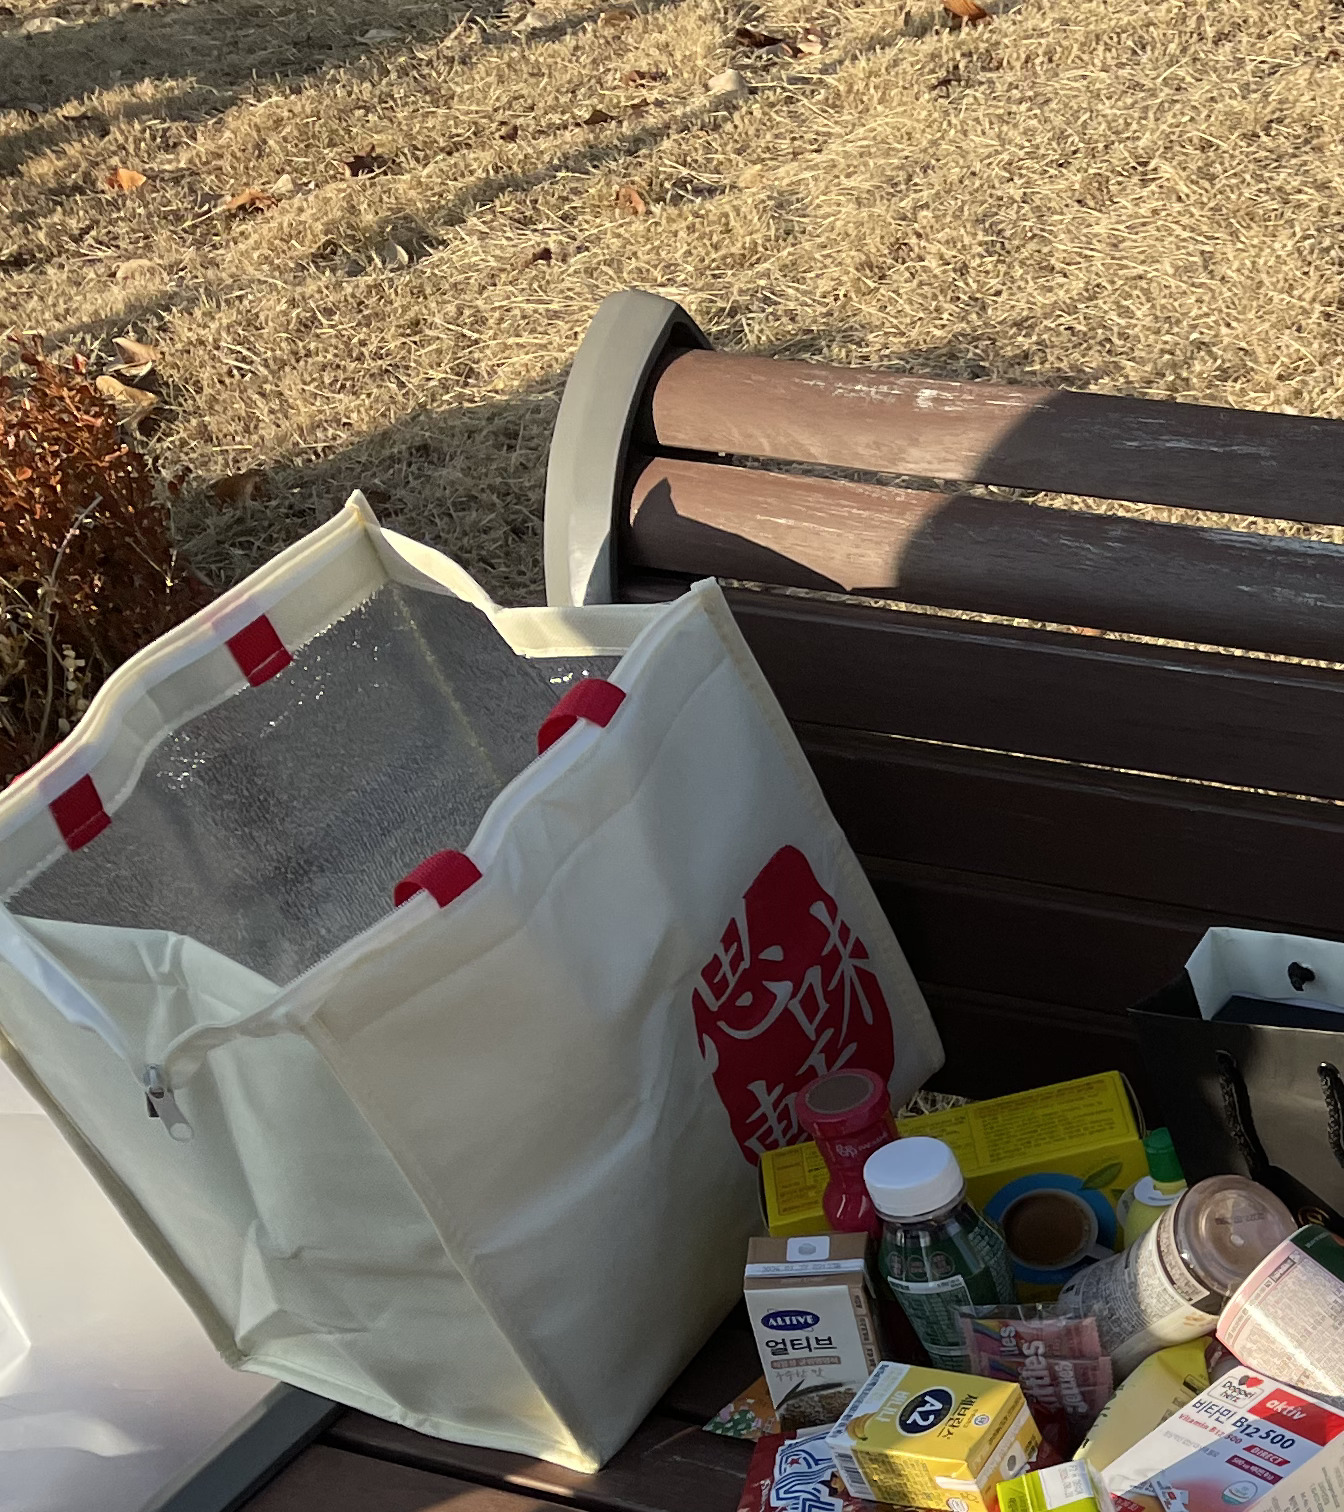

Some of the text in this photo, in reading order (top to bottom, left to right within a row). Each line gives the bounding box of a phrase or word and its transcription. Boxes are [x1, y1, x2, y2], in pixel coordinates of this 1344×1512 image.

[768, 1315, 816, 1327] ALTIVE
[765, 1336, 837, 1356] 얼티브
[907, 1395, 943, 1427] A2
[1266, 1398, 1307, 1421] aktiv
[1232, 1417, 1261, 1438] B12
[1259, 1429, 1296, 1450] 500
